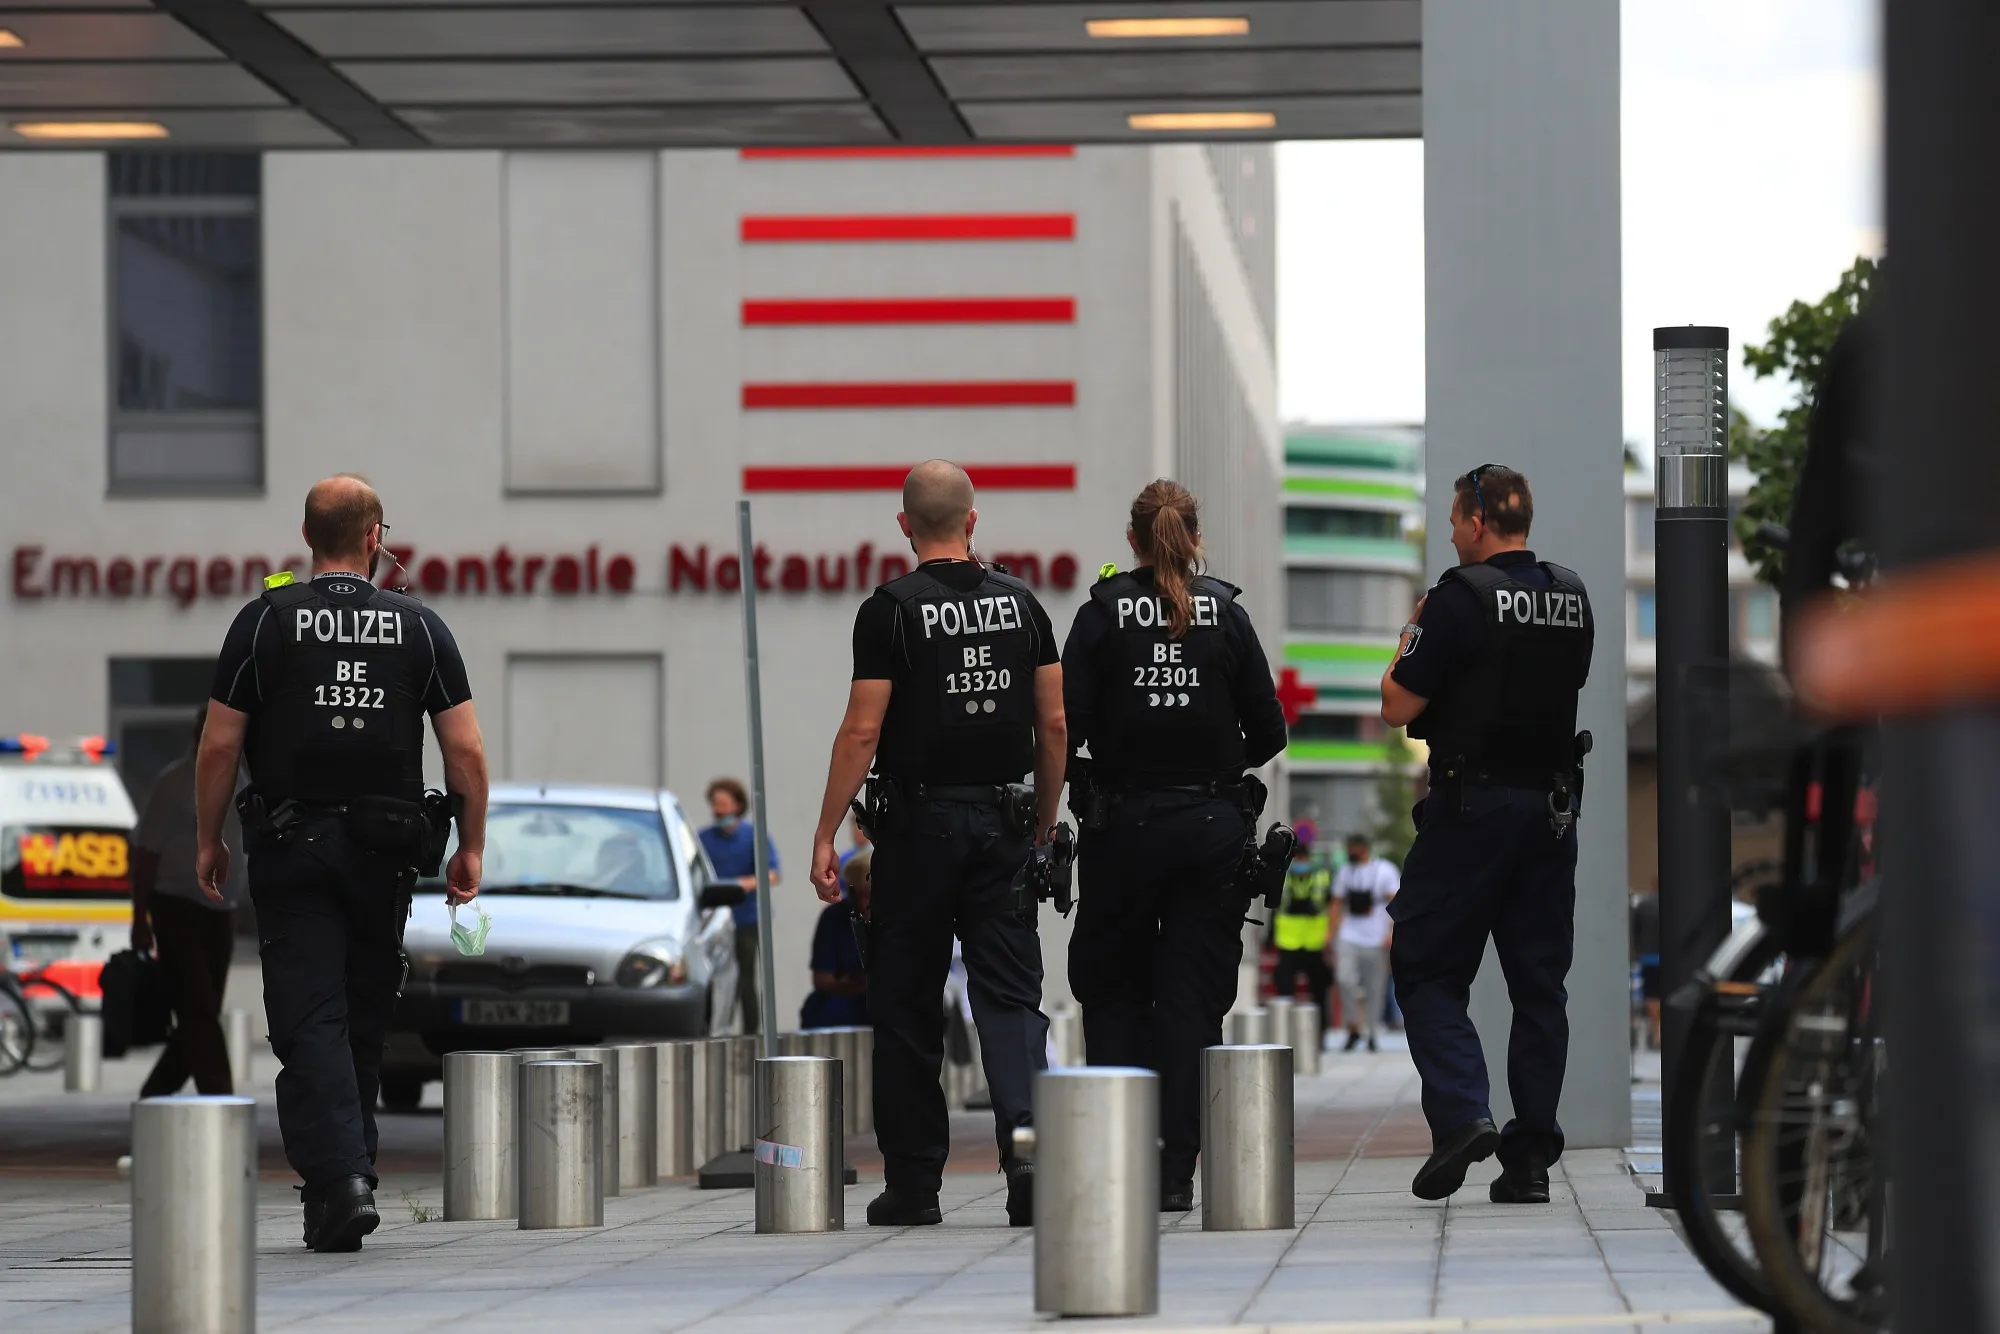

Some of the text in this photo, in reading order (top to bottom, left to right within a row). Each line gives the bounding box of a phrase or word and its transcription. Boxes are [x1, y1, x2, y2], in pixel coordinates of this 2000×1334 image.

[380, 544, 635, 595] Zentrale
[669, 542, 1078, 592] Notaufnme
[921, 596, 1022, 638] POLIZEI
[1118, 596, 1218, 628] POLEI
[1496, 590, 1584, 628] POLIZEI
[296, 608, 402, 644] POLIZEI
[963, 645, 992, 668] BE
[1153, 643, 1182, 663] BE
[336, 660, 367, 682] BE
[946, 668, 1011, 694] 13320
[1133, 666, 1200, 687] 22301
[314, 685, 385, 708] 13322
[54, 831, 129, 878] ASB
